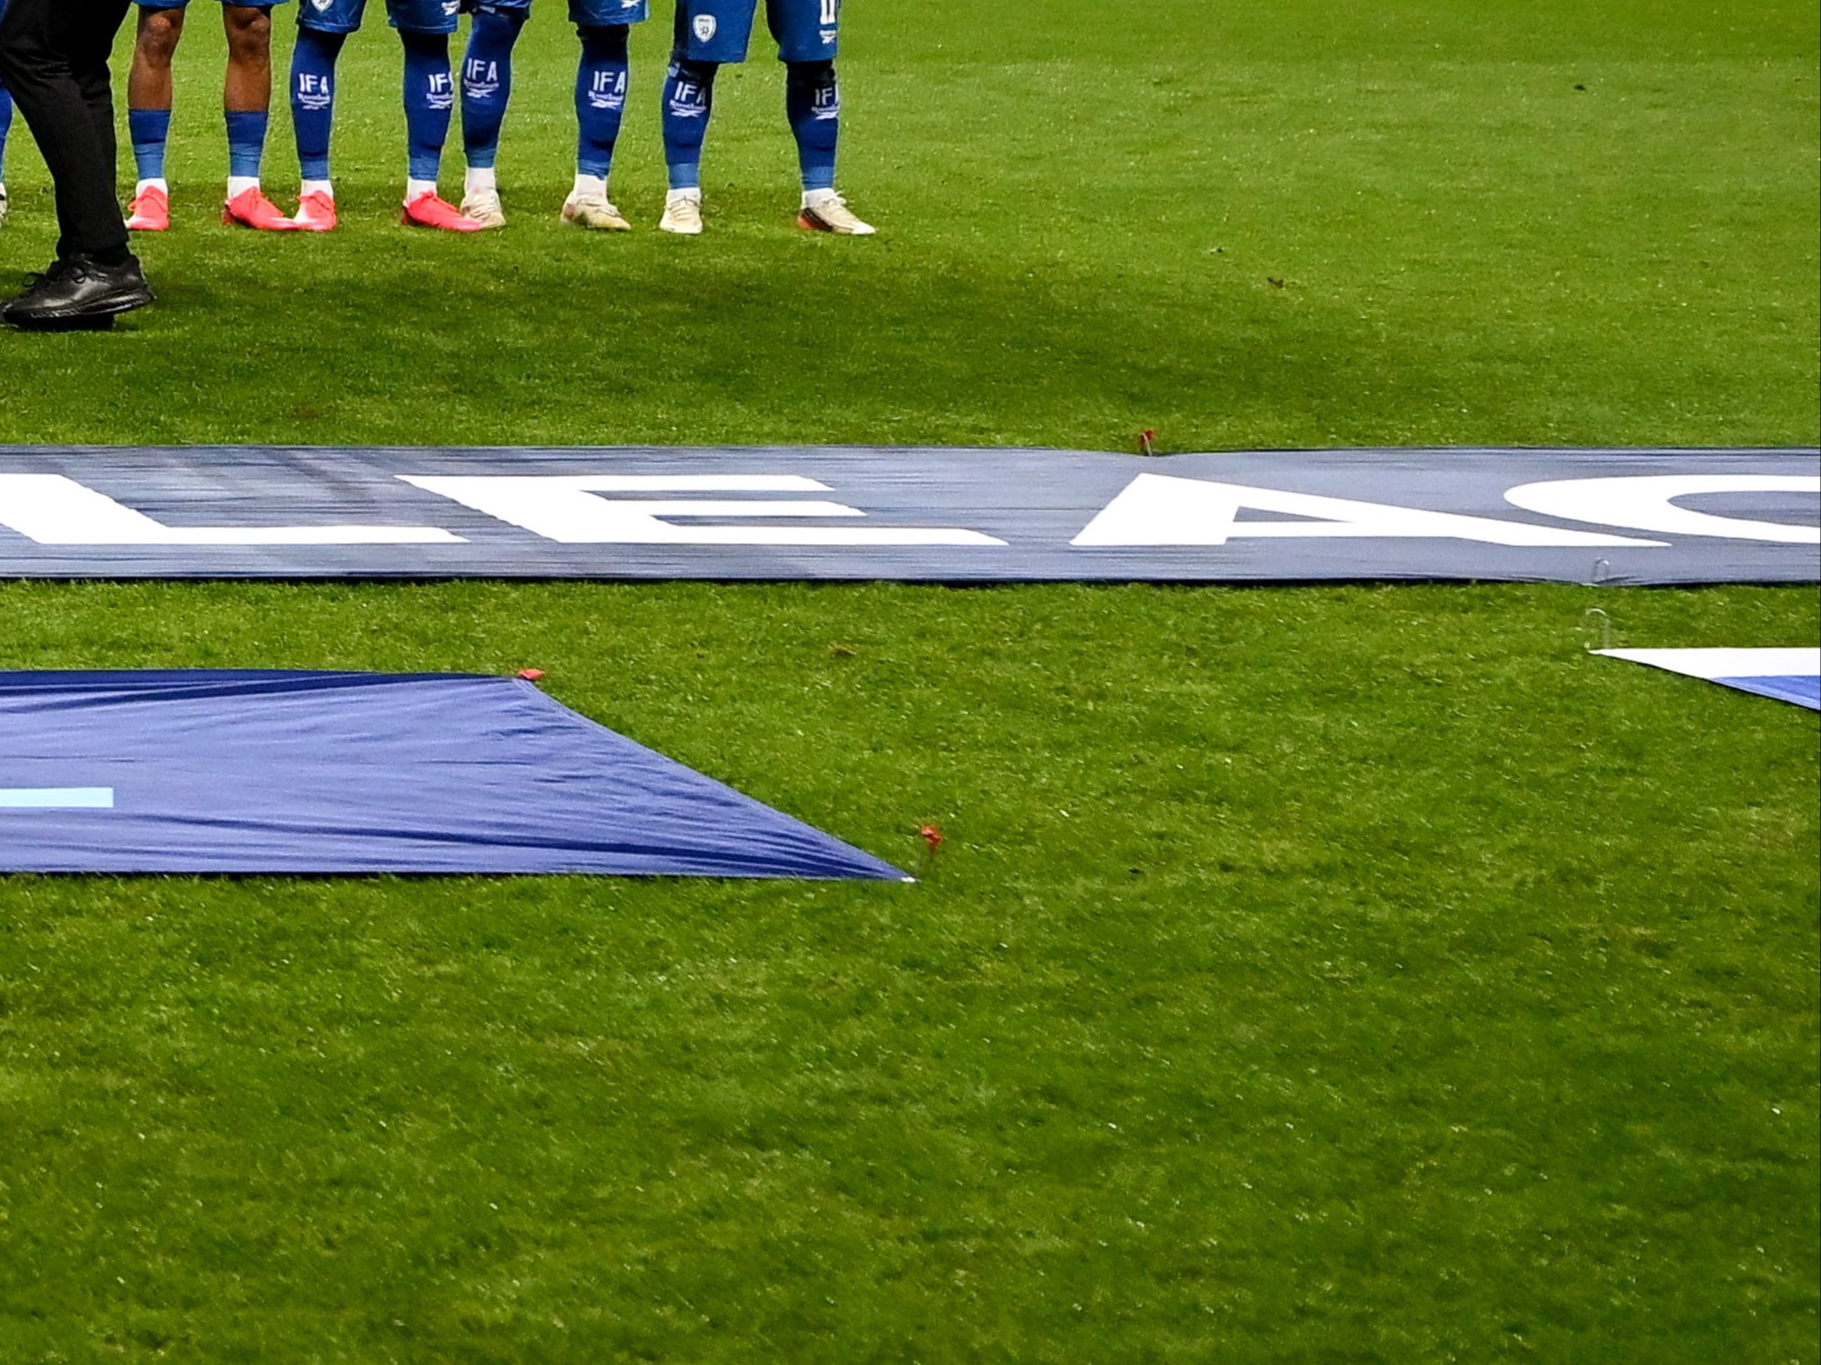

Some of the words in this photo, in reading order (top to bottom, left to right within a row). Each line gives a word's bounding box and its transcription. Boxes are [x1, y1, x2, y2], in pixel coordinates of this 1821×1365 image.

[466, 58, 498, 81] IFA
[299, 73, 329, 94] IFA
[593, 71, 625, 93] IFA
[674, 81, 706, 104] IFA
